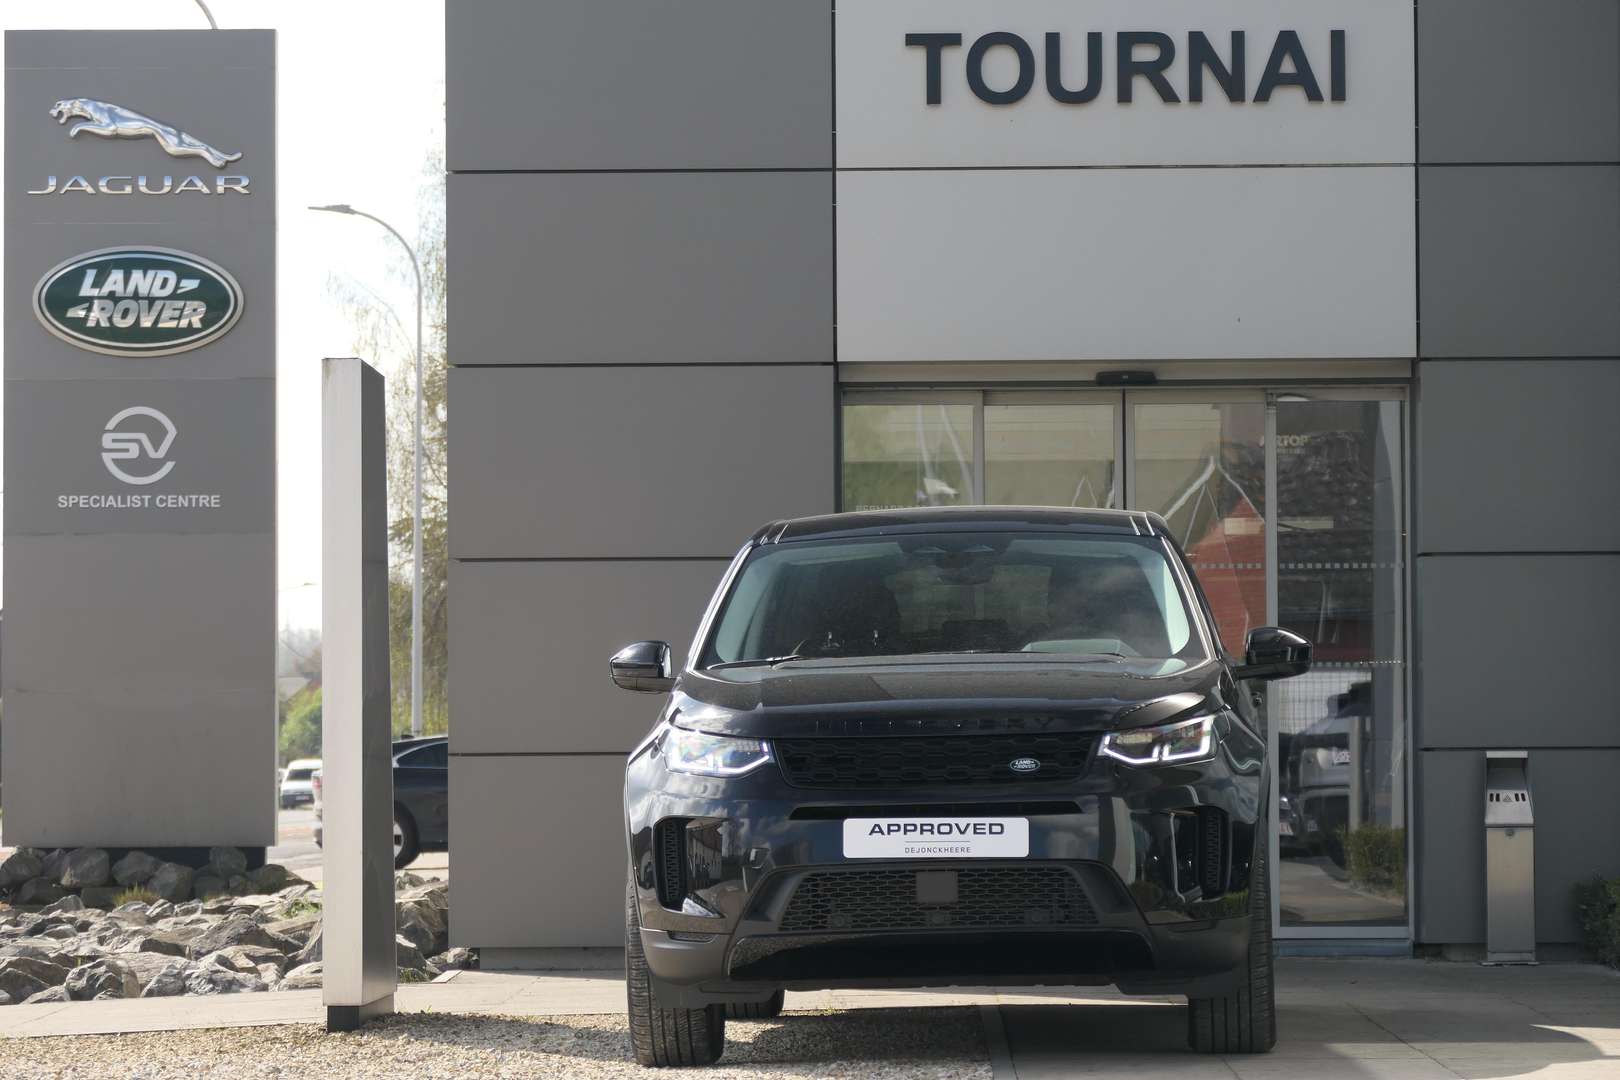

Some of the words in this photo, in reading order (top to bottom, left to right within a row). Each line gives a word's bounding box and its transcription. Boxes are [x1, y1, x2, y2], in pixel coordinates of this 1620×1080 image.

[905, 30, 1346, 105] TOURNAI
[27, 175, 251, 195] JAGUAR
[79, 269, 178, 297] LAND
[86, 299, 207, 328] ROVER
[57, 495, 151, 508] SPECIALIST
[156, 495, 221, 508] CENTRE
[868, 823, 1005, 836] APPROVED
[904, 846, 971, 854] DEJONCKHEERE
